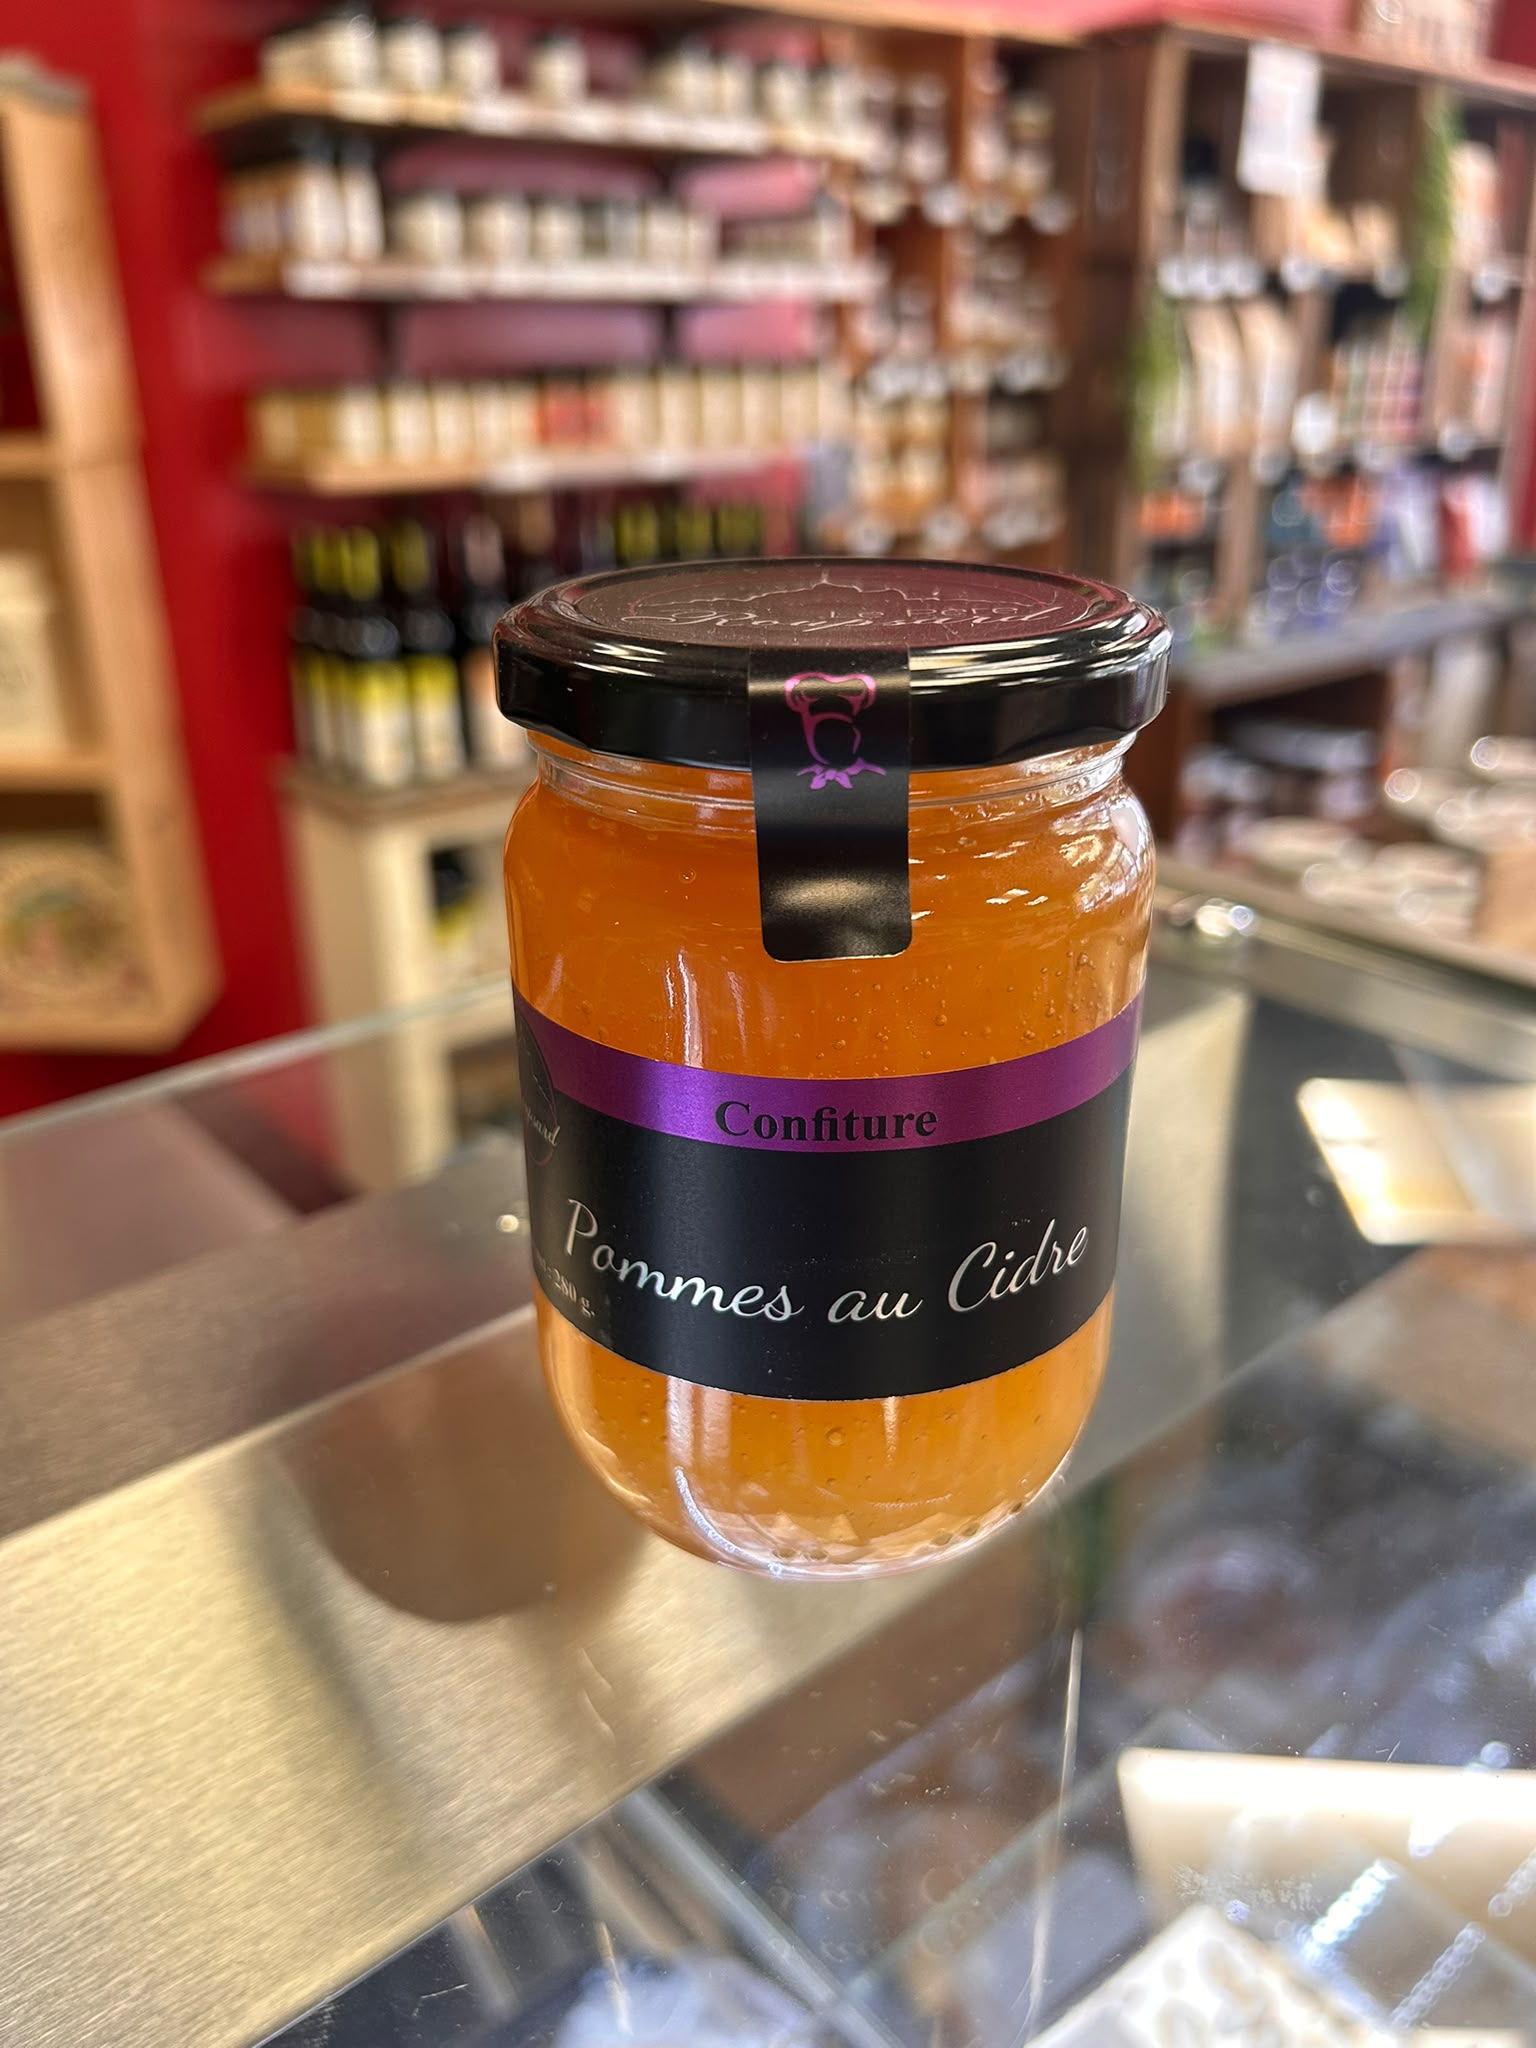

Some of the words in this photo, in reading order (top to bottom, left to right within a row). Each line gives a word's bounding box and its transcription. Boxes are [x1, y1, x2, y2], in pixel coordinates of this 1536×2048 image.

[715, 1100, 938, 1142] Confiture
[567, 1199, 804, 1322] Pommes
[827, 1290, 924, 1323] au
[948, 1218, 1089, 1313] Cidre
